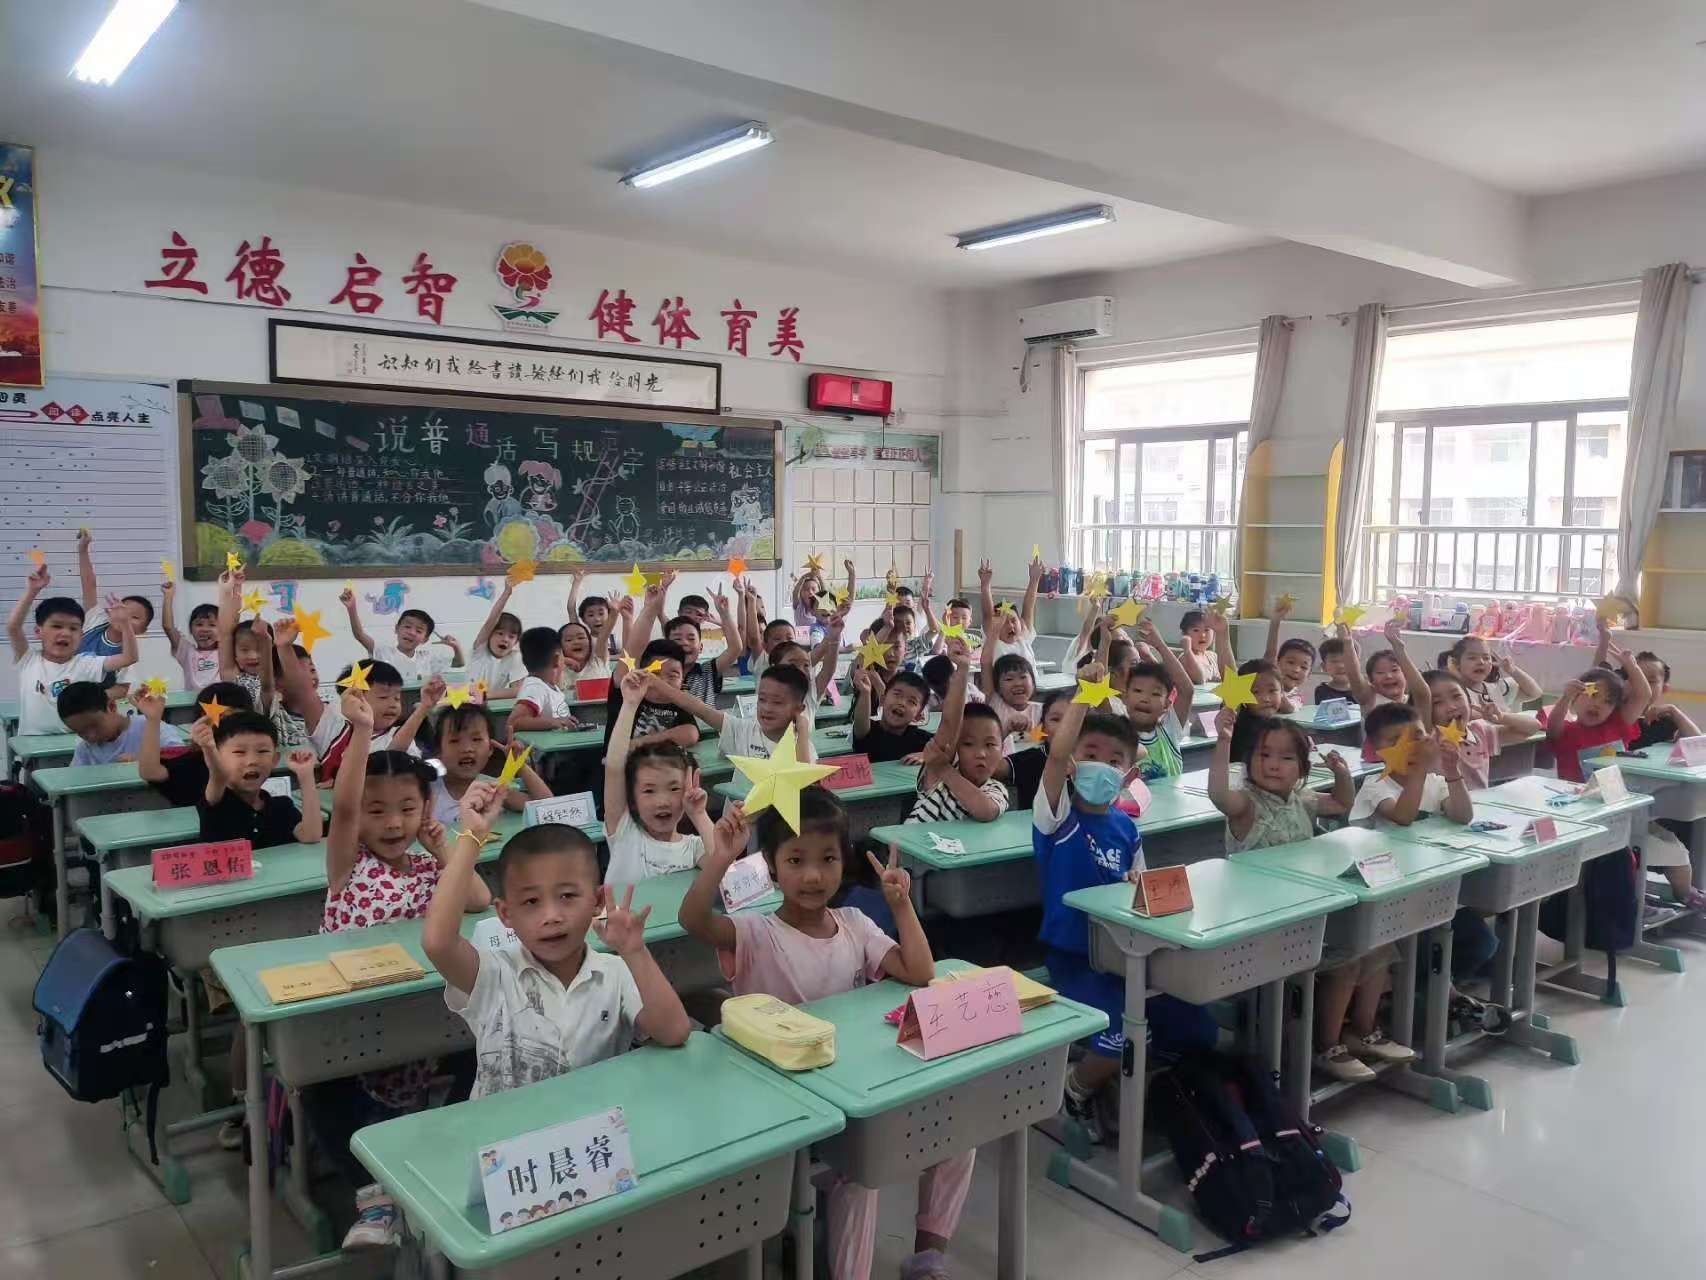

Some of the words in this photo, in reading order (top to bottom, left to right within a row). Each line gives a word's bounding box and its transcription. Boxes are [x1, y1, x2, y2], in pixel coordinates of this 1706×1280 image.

[146, 231, 293, 307] 立德
[331, 252, 458, 326] 启智
[589, 287, 701, 348] 健体
[720, 299, 806, 362] 育美
[91, 410, 151, 424] 点亮人生
[506, 1134, 614, 1197] 时晨睿
